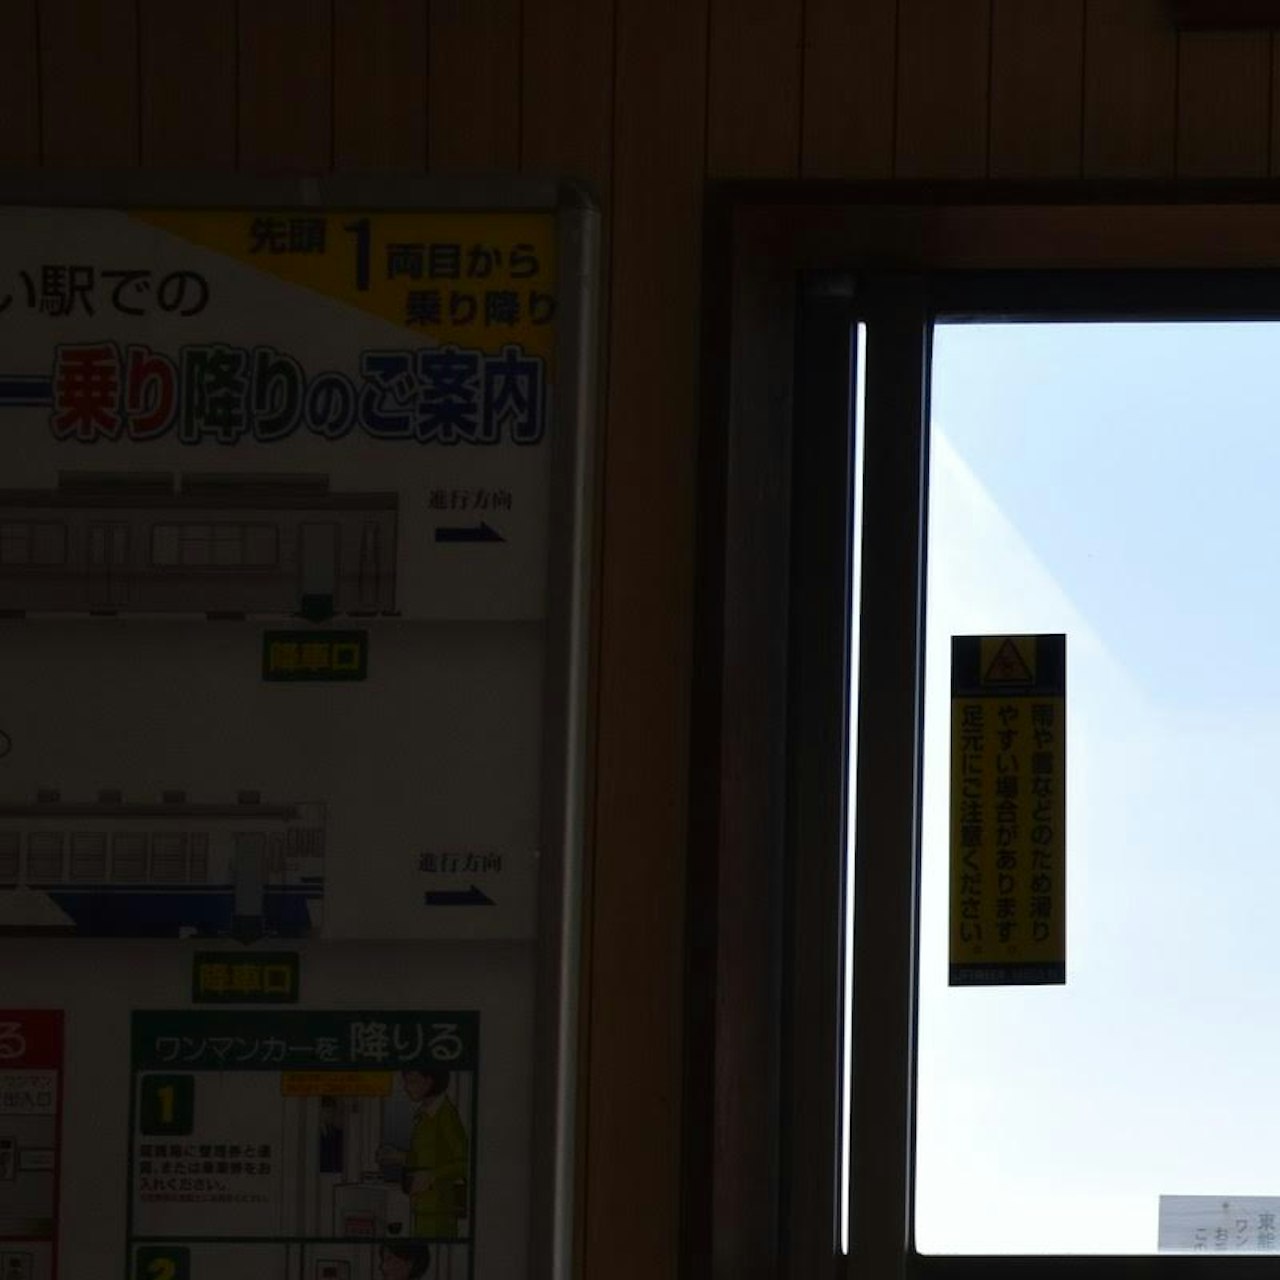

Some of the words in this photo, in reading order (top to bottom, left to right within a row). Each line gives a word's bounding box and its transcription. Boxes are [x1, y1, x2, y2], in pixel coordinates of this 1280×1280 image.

[428, 488, 513, 511] 進行方向
[418, 852, 502, 873] 進行方向
[156, 1086, 173, 1124] 1
